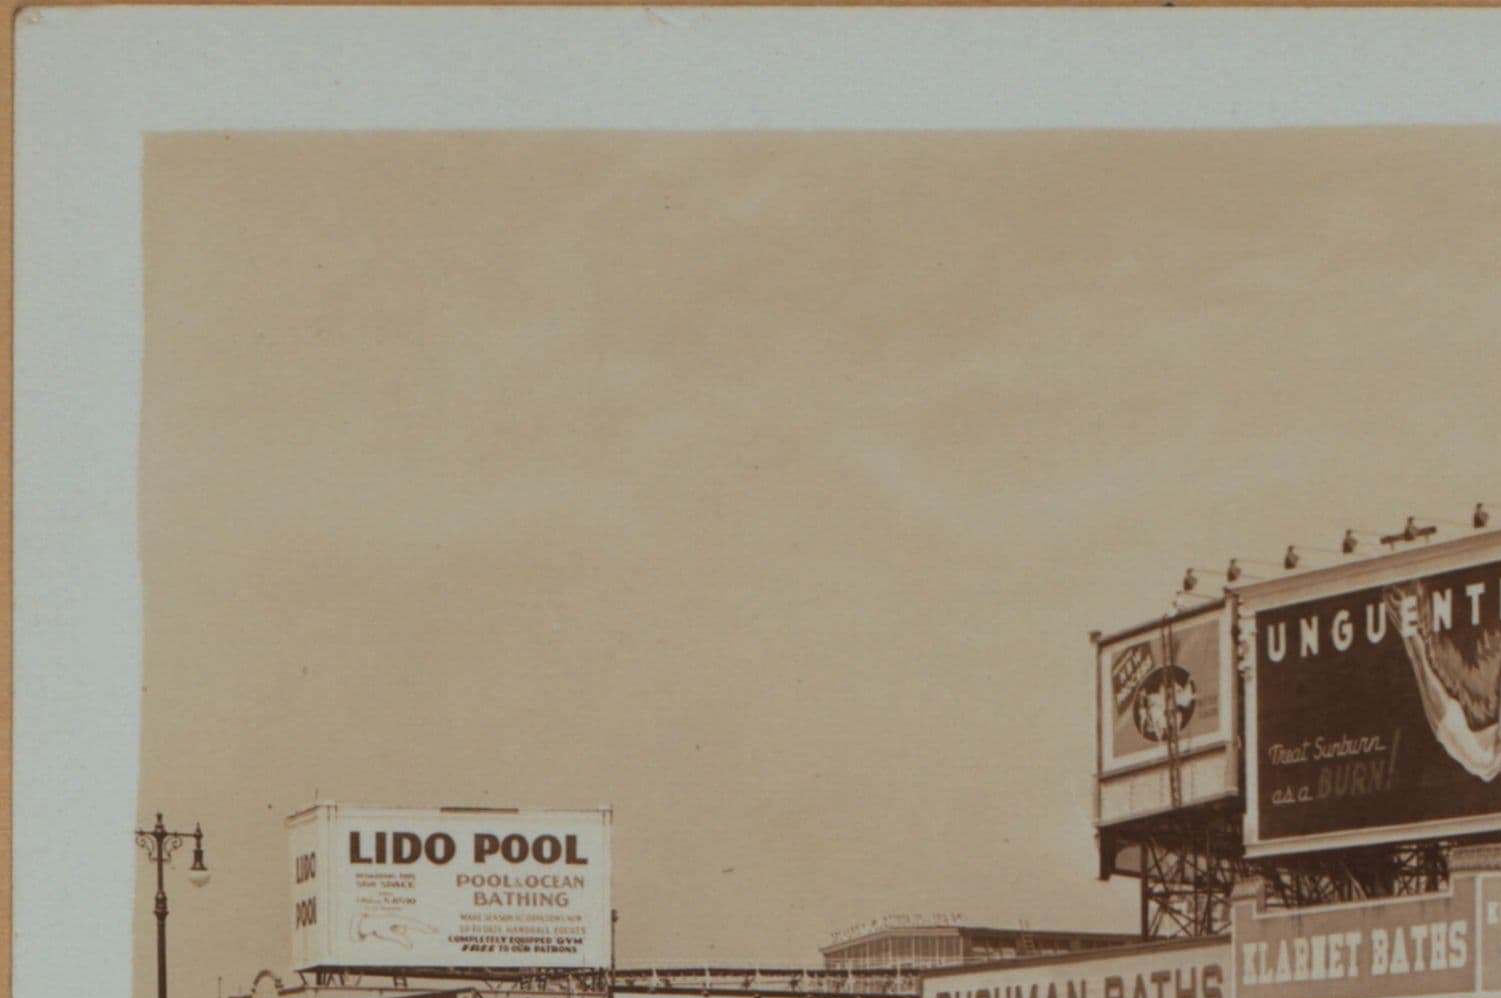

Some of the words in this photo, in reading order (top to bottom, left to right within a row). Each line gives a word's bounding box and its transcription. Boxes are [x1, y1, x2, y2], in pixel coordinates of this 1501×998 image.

[1268, 742, 1312, 765] Treat
[1314, 734, 1387, 760] Sunburn
[349, 832, 456, 865] LIDO
[473, 833, 588, 865] POOL
[296, 852, 316, 884] LIDO
[456, 874, 511, 888] POOL
[523, 875, 585, 888] OCEAN
[473, 891, 569, 907] BATHING
[448, 936, 507, 944] COMPLETELY
[461, 945, 495, 953] FREE
[1242, 932, 1362, 985] KLARNET
[1371, 919, 1467, 976] BATHS
